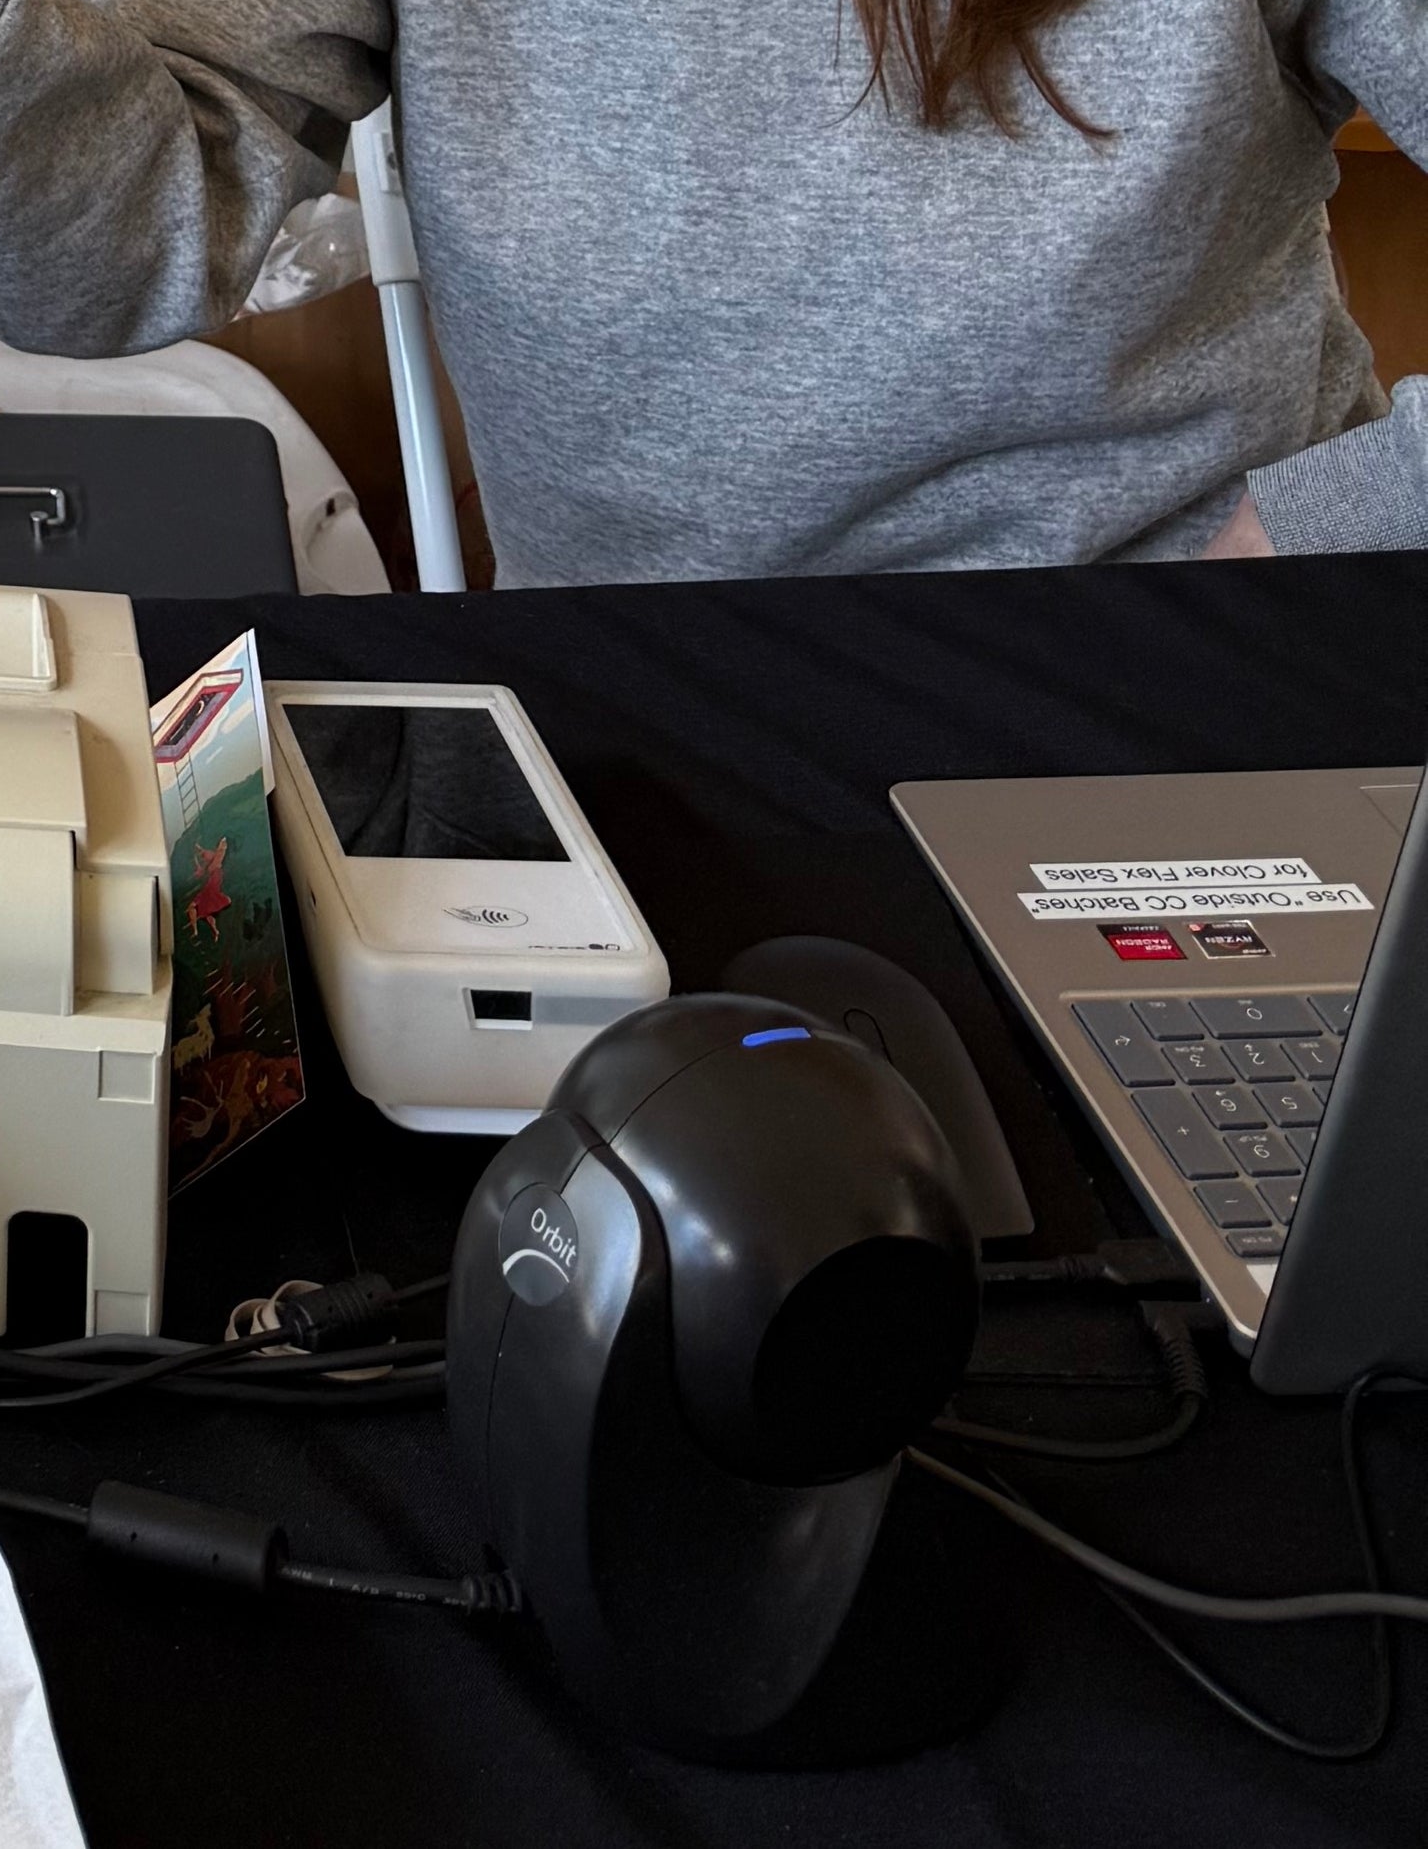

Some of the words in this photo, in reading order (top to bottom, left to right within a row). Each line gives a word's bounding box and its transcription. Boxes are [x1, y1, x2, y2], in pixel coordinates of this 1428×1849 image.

[1044, 867, 1118, 883] Sales
[1125, 866, 1180, 882] Flex
[1185, 865, 1267, 880] Clover
[1273, 863, 1309, 878] for
[1031, 895, 1141, 913] Batches"
[1148, 895, 1187, 910] CC
[1193, 890, 1304, 907] "Outside
[1307, 889, 1363, 904] Use
[1205, 935, 1253, 945] RYZEN
[529, 1206, 579, 1270] Orbit
